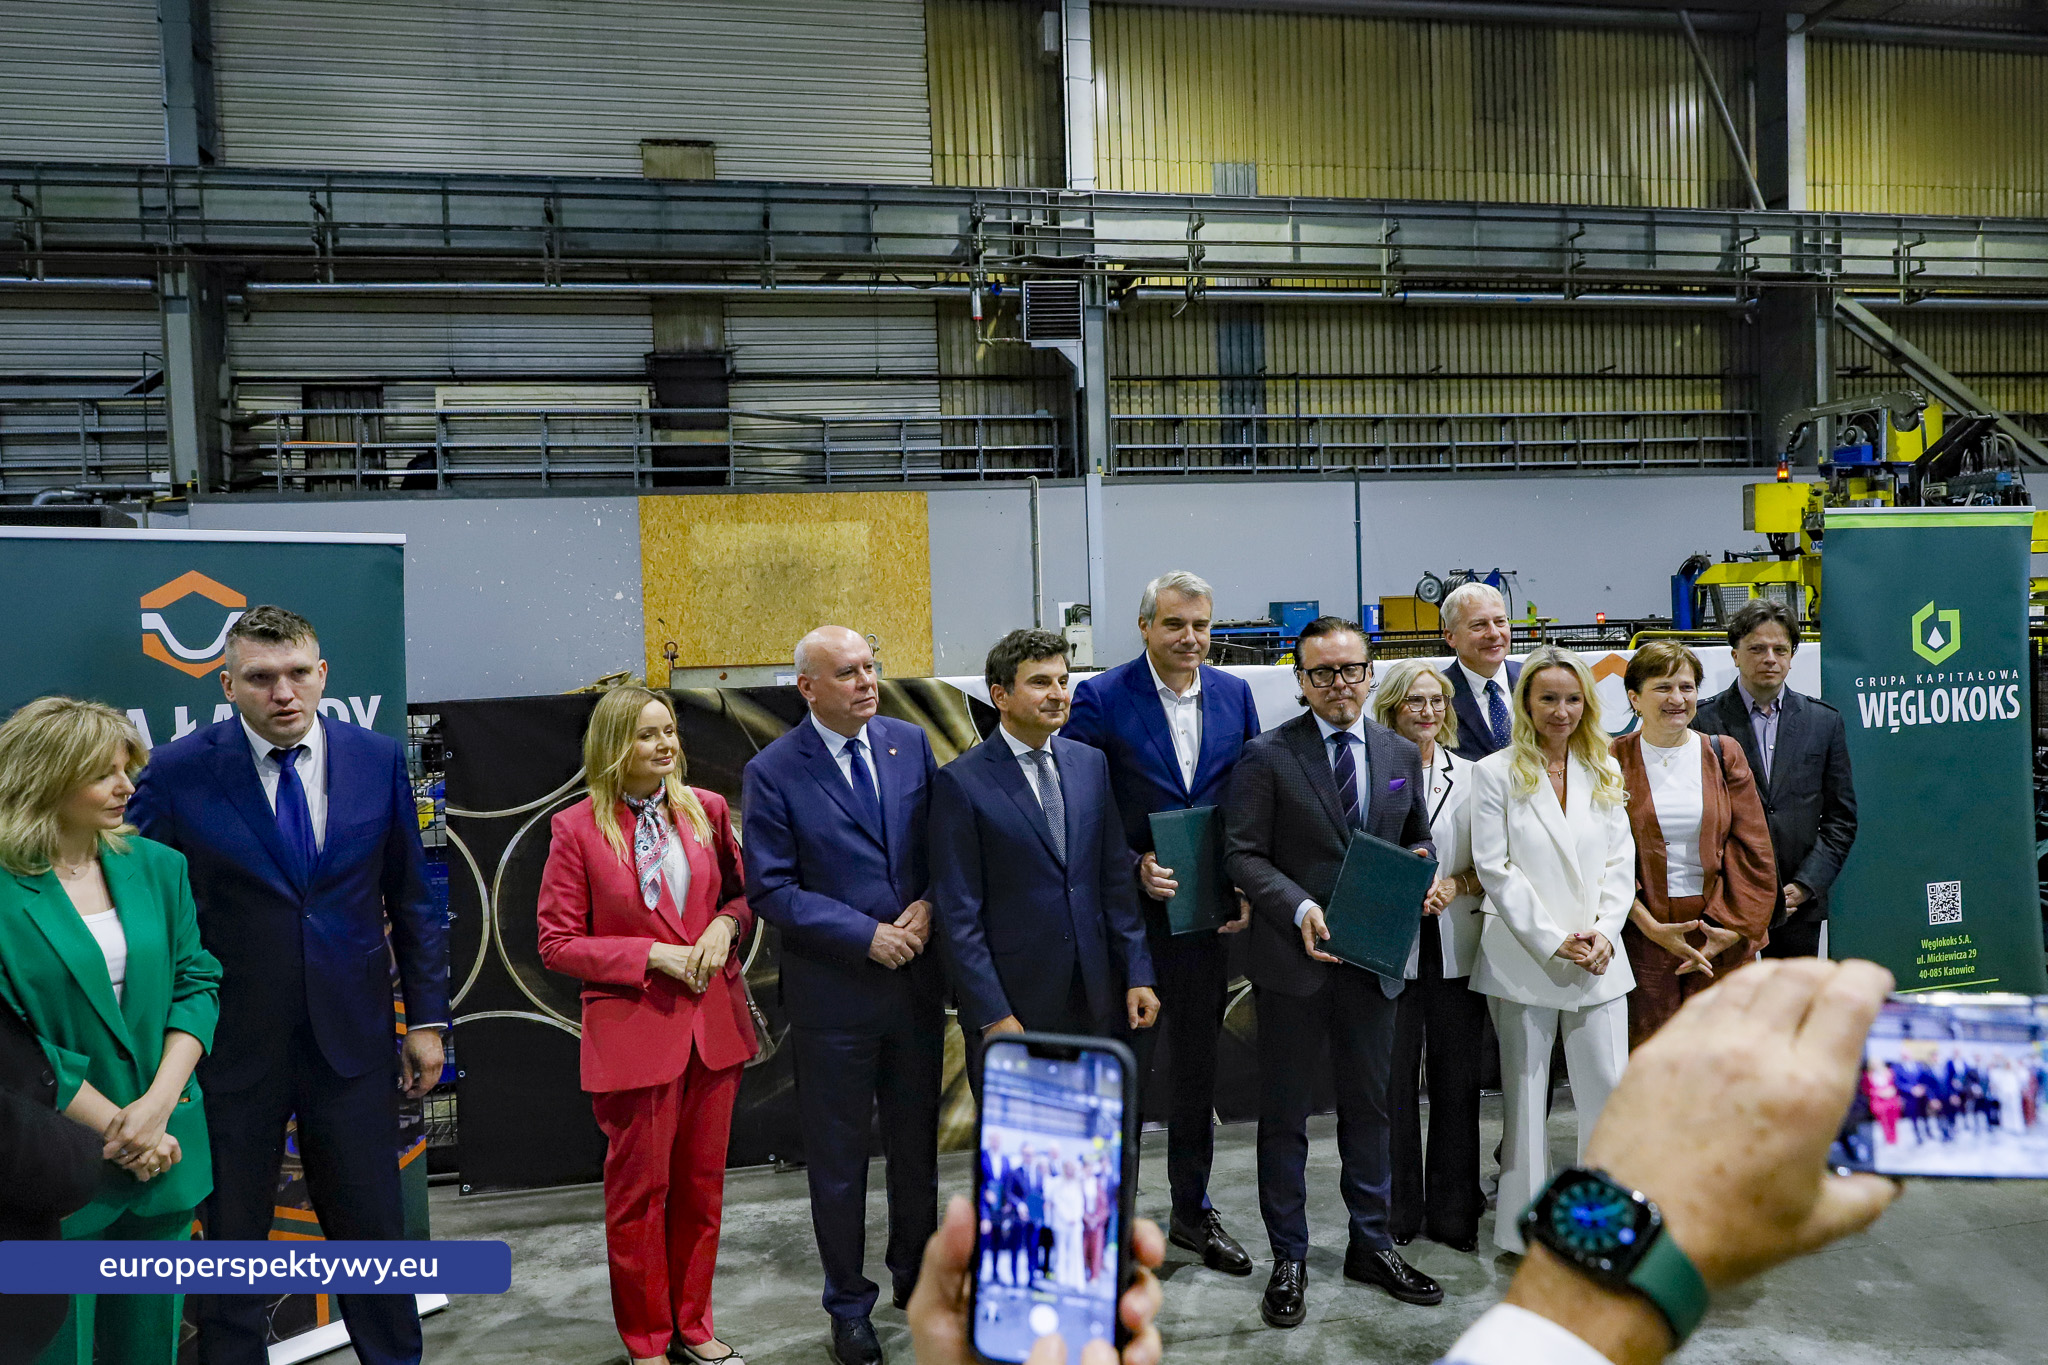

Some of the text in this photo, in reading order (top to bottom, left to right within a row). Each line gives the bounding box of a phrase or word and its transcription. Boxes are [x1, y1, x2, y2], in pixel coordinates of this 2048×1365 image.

[1855, 669, 2019, 688] GRUPA KAPITAŁOWA
[1857, 684, 2021, 734] WĘGLOKOKS
[1921, 934, 1972, 950] Węglokoks S.A.
[1916, 948, 1977, 965] ul. Mickiewicza 29
[1919, 964, 1975, 979] 40-085 Katowice
